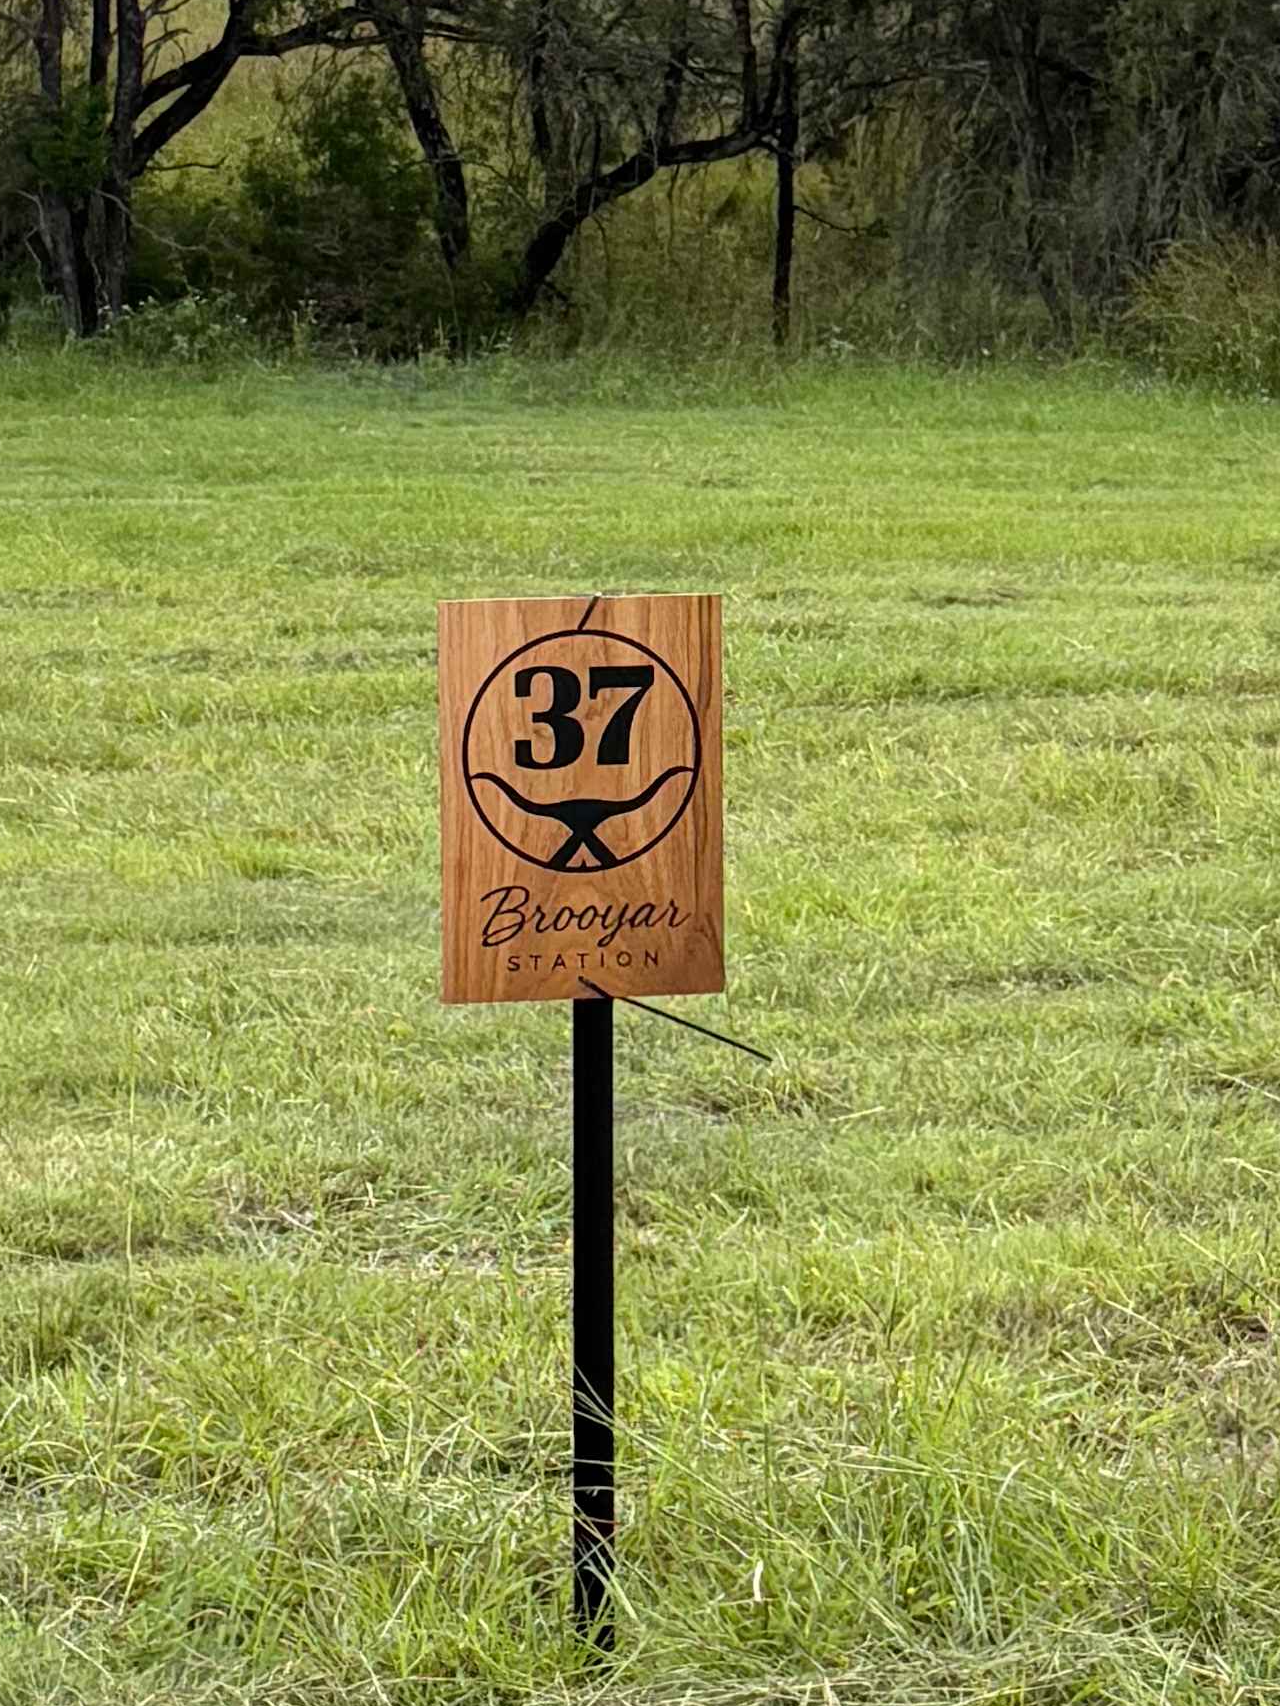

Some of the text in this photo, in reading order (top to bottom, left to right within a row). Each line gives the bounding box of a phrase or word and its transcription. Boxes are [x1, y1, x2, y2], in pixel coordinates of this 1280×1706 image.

[513, 664, 655, 770] 37
[480, 885, 691, 948] Brooyar
[506, 950, 659, 973] STATION
